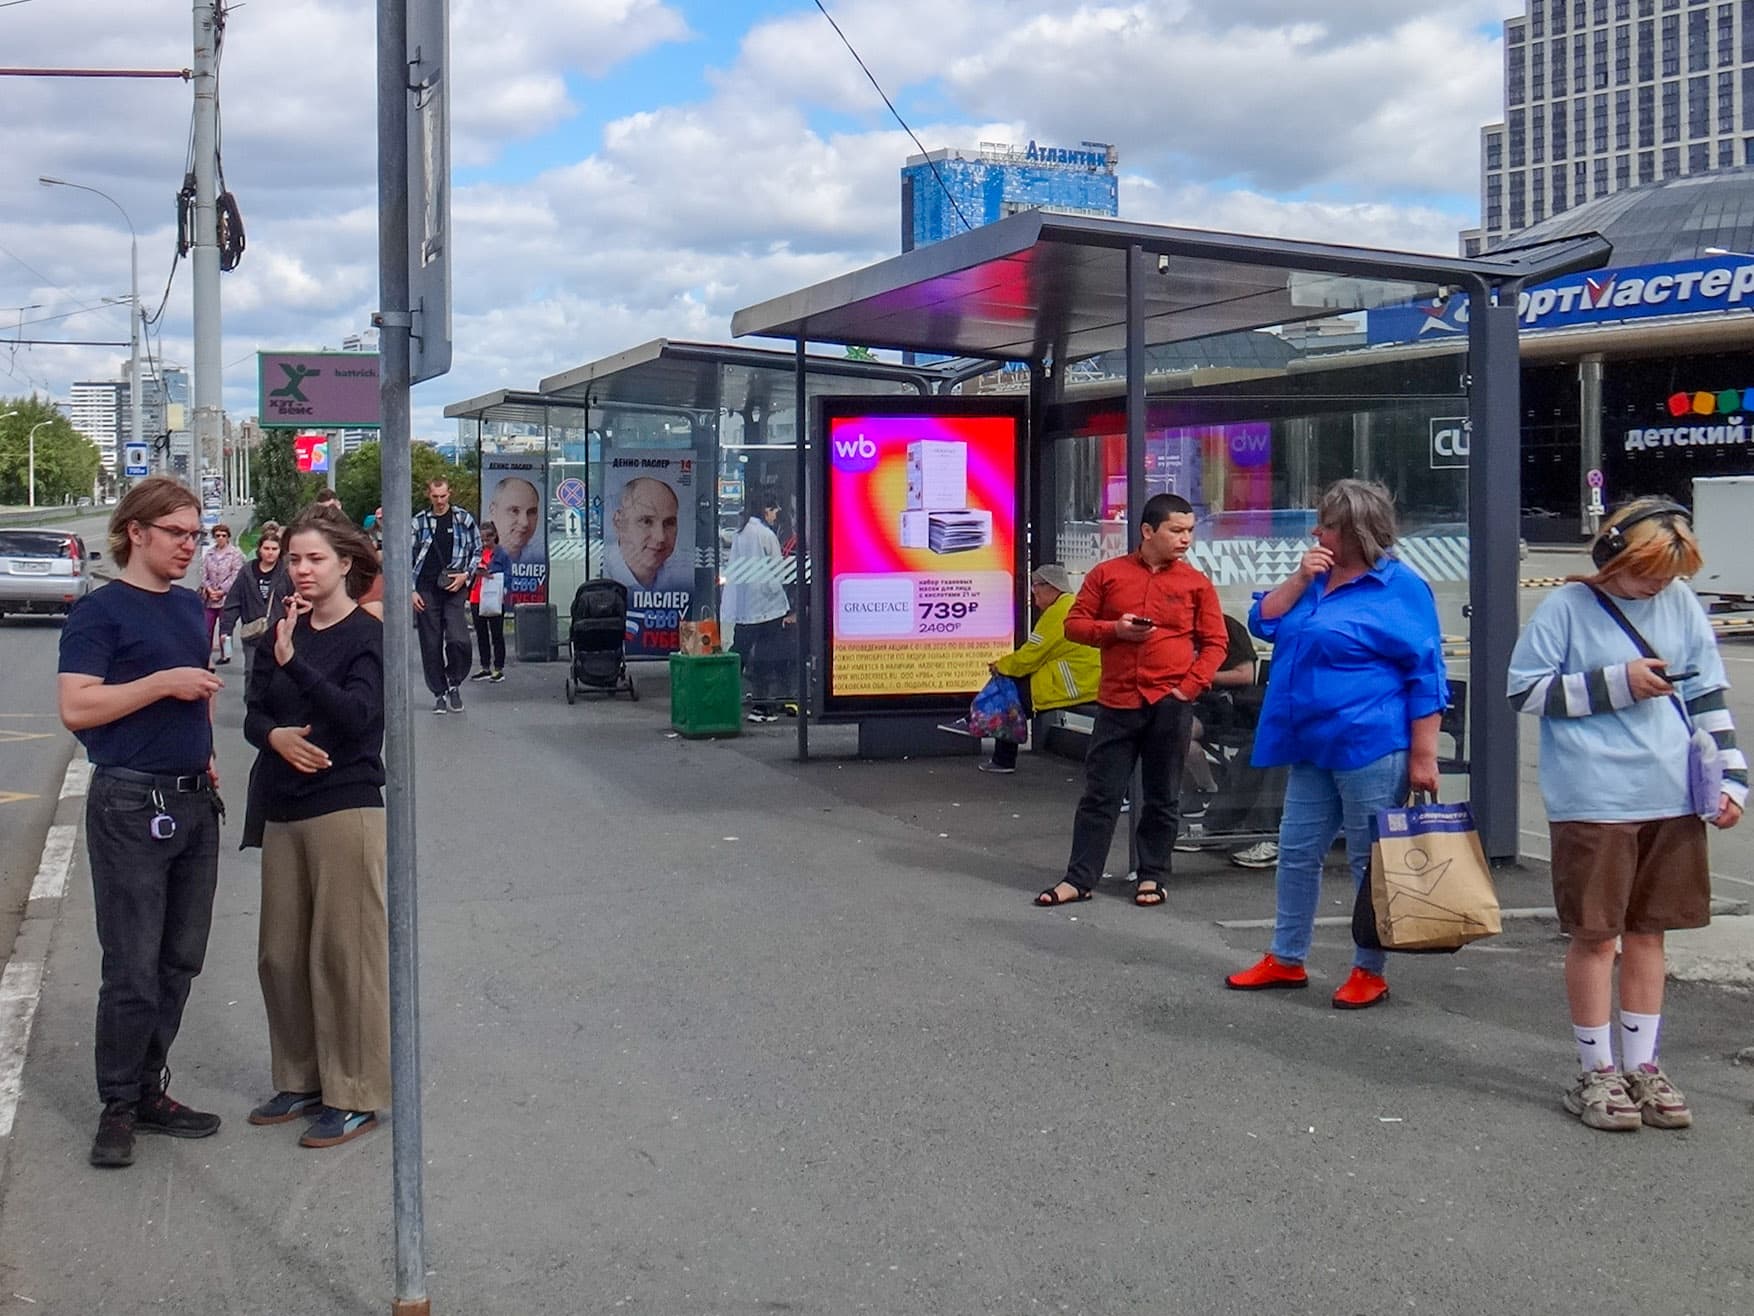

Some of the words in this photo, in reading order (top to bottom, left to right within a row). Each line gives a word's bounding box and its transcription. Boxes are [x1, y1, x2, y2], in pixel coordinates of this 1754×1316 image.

[1026, 139, 1107, 168] Атлантик
[1625, 416, 1745, 451] детский
[835, 433, 876, 458] wb
[511, 563, 546, 577] АСЛЕР
[633, 591, 689, 609] ПАСЛЕР
[844, 602, 909, 613] GRACEFACE
